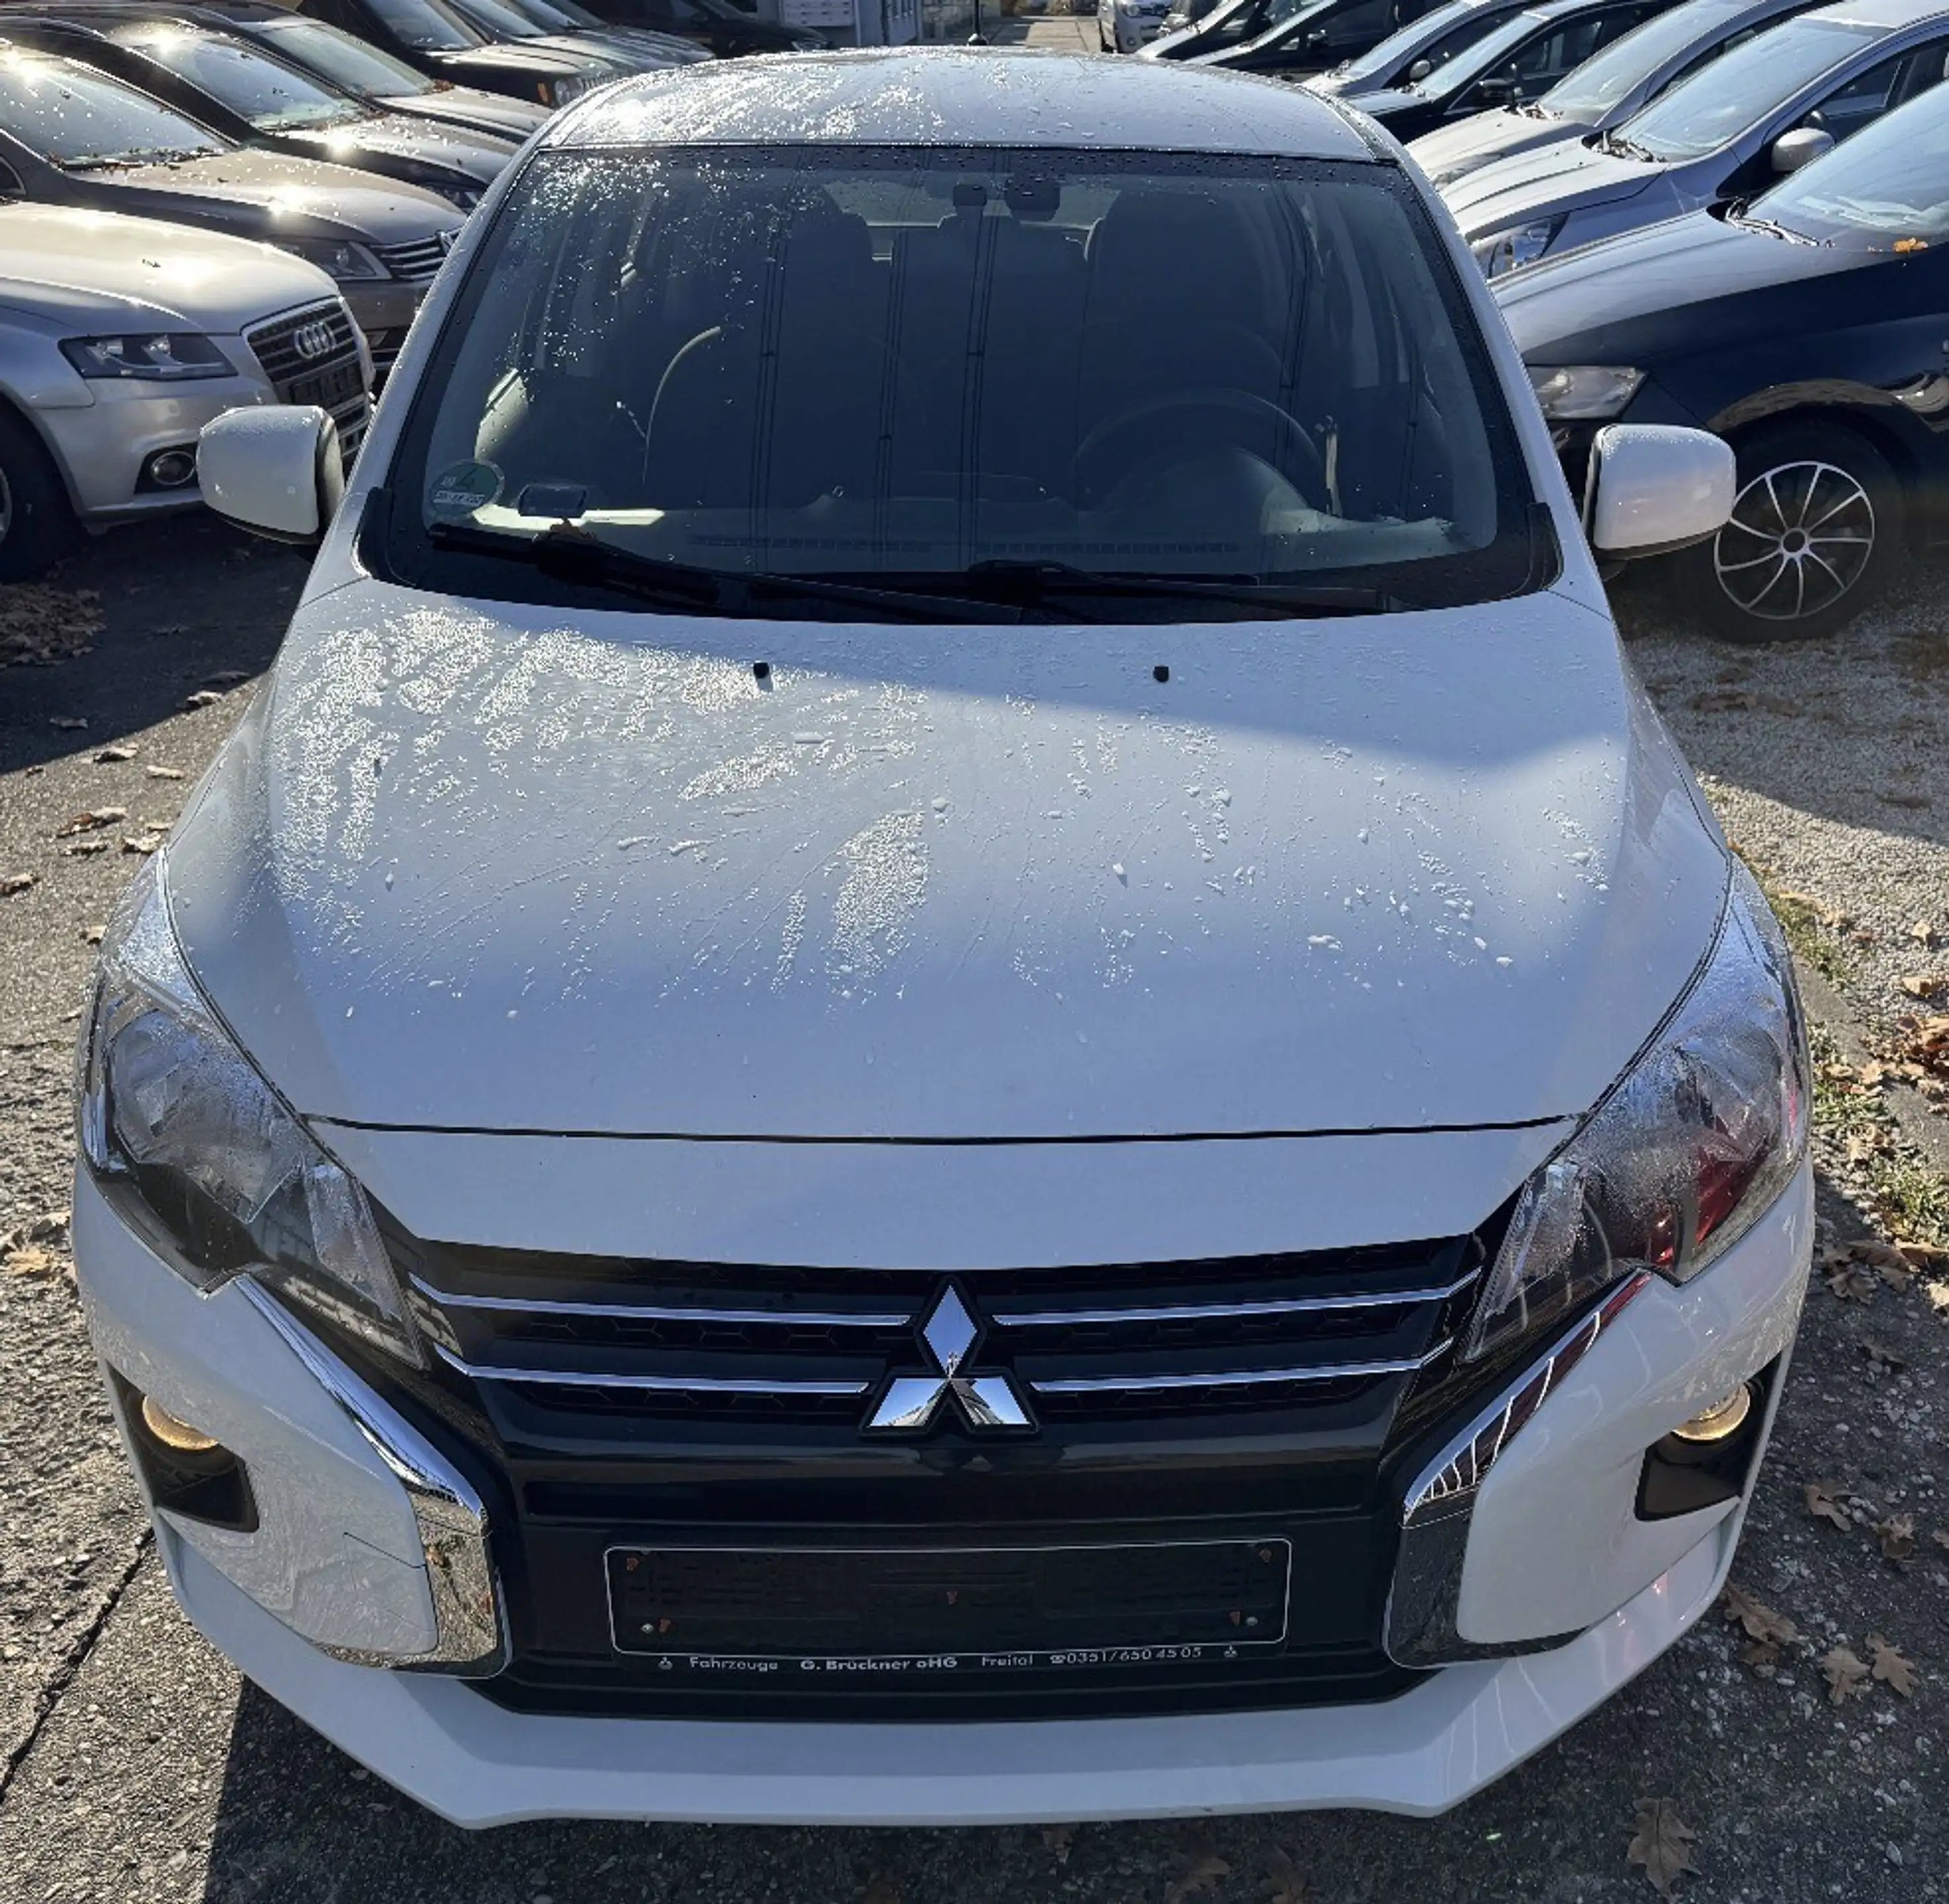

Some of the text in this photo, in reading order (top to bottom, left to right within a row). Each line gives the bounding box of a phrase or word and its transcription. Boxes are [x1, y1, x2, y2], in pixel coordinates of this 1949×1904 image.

[690, 1656, 779, 1672] Fahrzeuge
[826, 1658, 910, 1671] Brückner
[981, 1654, 1033, 1667] Freital
